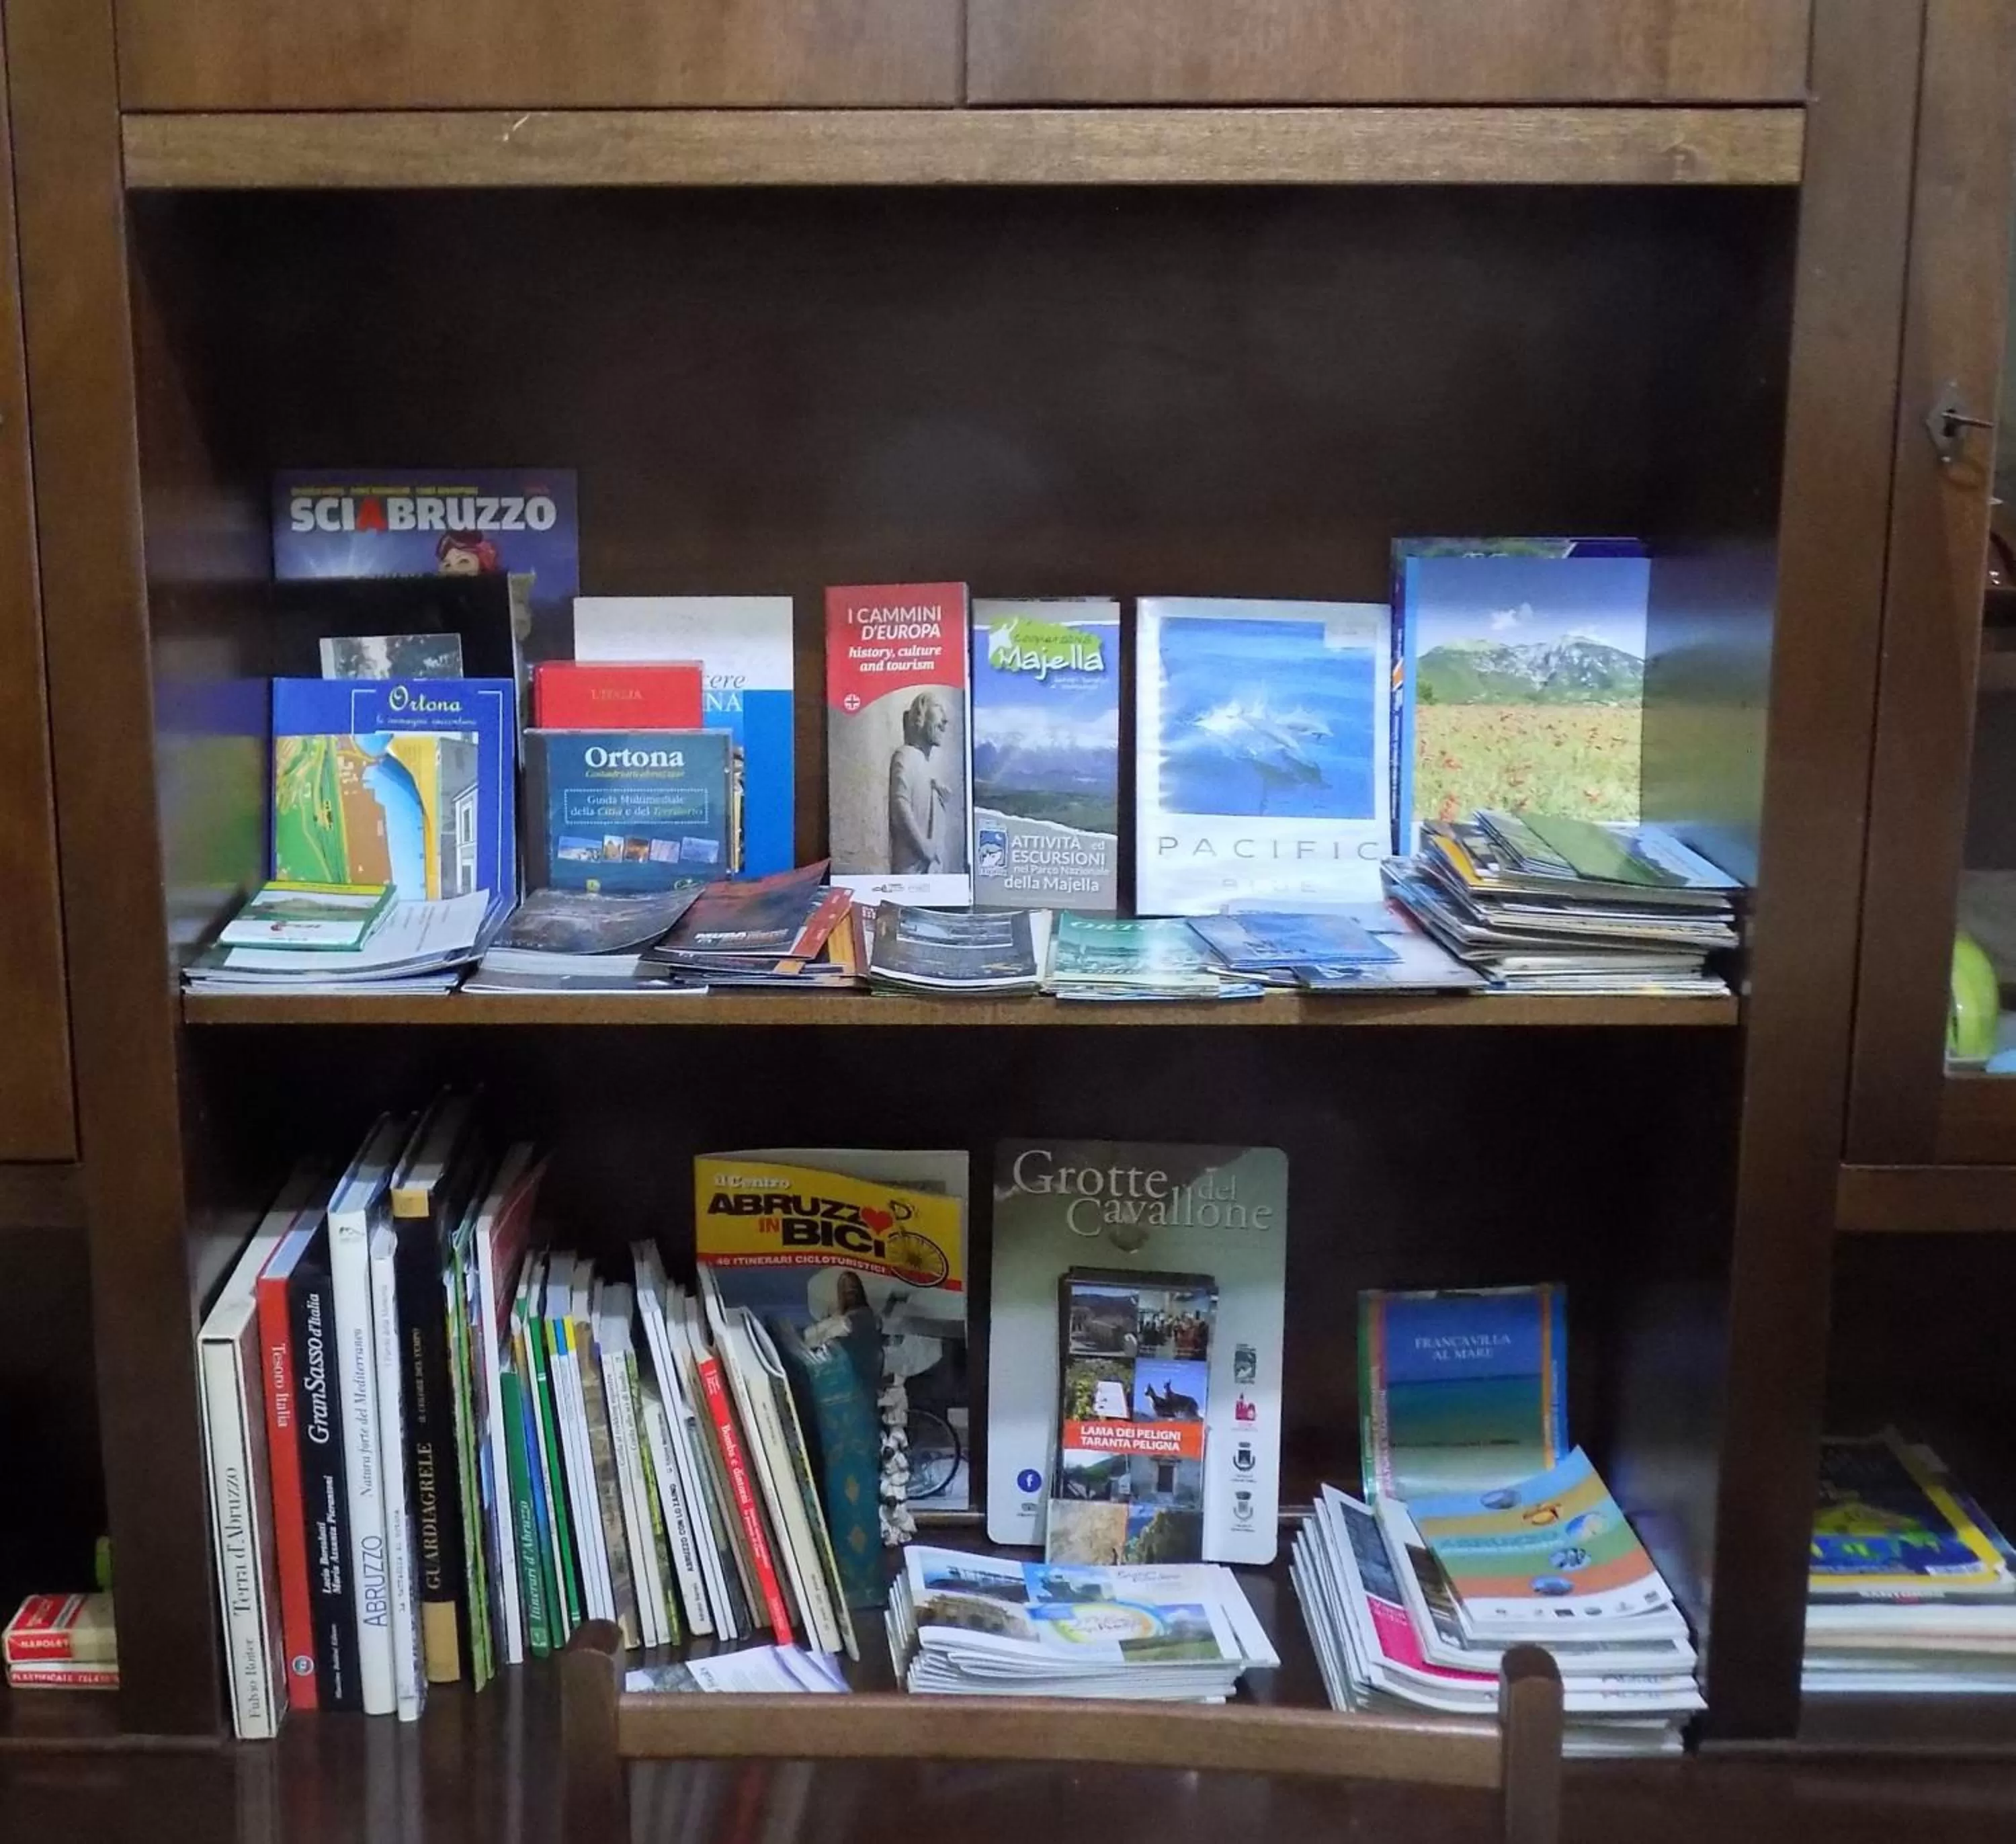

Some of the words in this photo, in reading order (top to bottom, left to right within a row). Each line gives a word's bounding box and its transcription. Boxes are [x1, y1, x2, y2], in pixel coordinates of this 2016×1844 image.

[290, 495, 556, 532] SCIABRUZZO
[848, 608, 853, 624] I
[857, 605, 941, 624] CAMMINI
[862, 624, 941, 640] D'EUROPA
[849, 646, 895, 659] history,
[898, 646, 942, 657] culture
[999, 644, 1104, 681] Majella
[860, 660, 884, 671] and
[887, 659, 935, 671] tourism
[707, 675, 746, 689] ere
[389, 685, 464, 712] Ortona
[585, 747, 684, 768] Ortona
[571, 807, 595, 816] della
[634, 806, 650, 816] del
[587, 795, 618, 805] Guida
[1091, 840, 1105, 850] ed
[1158, 836, 1380, 861] PACIFIC
[1012, 850, 1106, 867] ESCURSIONI
[1005, 876, 1040, 890] della
[1043, 877, 1100, 893] Majella
[1013, 1150, 1168, 1199] Grotte
[1199, 1174, 1238, 1202] del
[1066, 1185, 1273, 1238] Cavallone
[759, 1218, 780, 1233] IN
[782, 1218, 886, 1258] BICI
[732, 1255, 793, 1266] ITINERARI
[795, 1255, 887, 1274] CICLOTURISTICI
[1414, 1334, 1511, 1349] FRANCAVILLA
[1431, 1351, 1448, 1361] AL
[1454, 1347, 1493, 1359] MARE
[271, 1343, 286, 1389] Tesoro
[353, 1328, 368, 1405] Mediterraneo
[276, 1392, 291, 1428] Italia
[359, 1406, 369, 1425] del
[1081, 1426, 1116, 1438] LAMA
[1117, 1427, 1135, 1439] DEI
[1137, 1429, 1181, 1441] PELIGNI
[1081, 1437, 1130, 1450] TARANTA
[1132, 1439, 1181, 1452] PELIGNA
[226, 1467, 249, 1561] d'Abruzzo
[416, 1443, 441, 1589] GUARDIAGRELE
[520, 1501, 538, 1566] d'Abruzzo
[676, 1519, 686, 1535] CON
[679, 1537, 694, 1572] ABRUZZO
[234, 1565, 252, 1616] Terra
[361, 1534, 388, 1628] ABRUZZO
[525, 1566, 542, 1621] Itinerari
